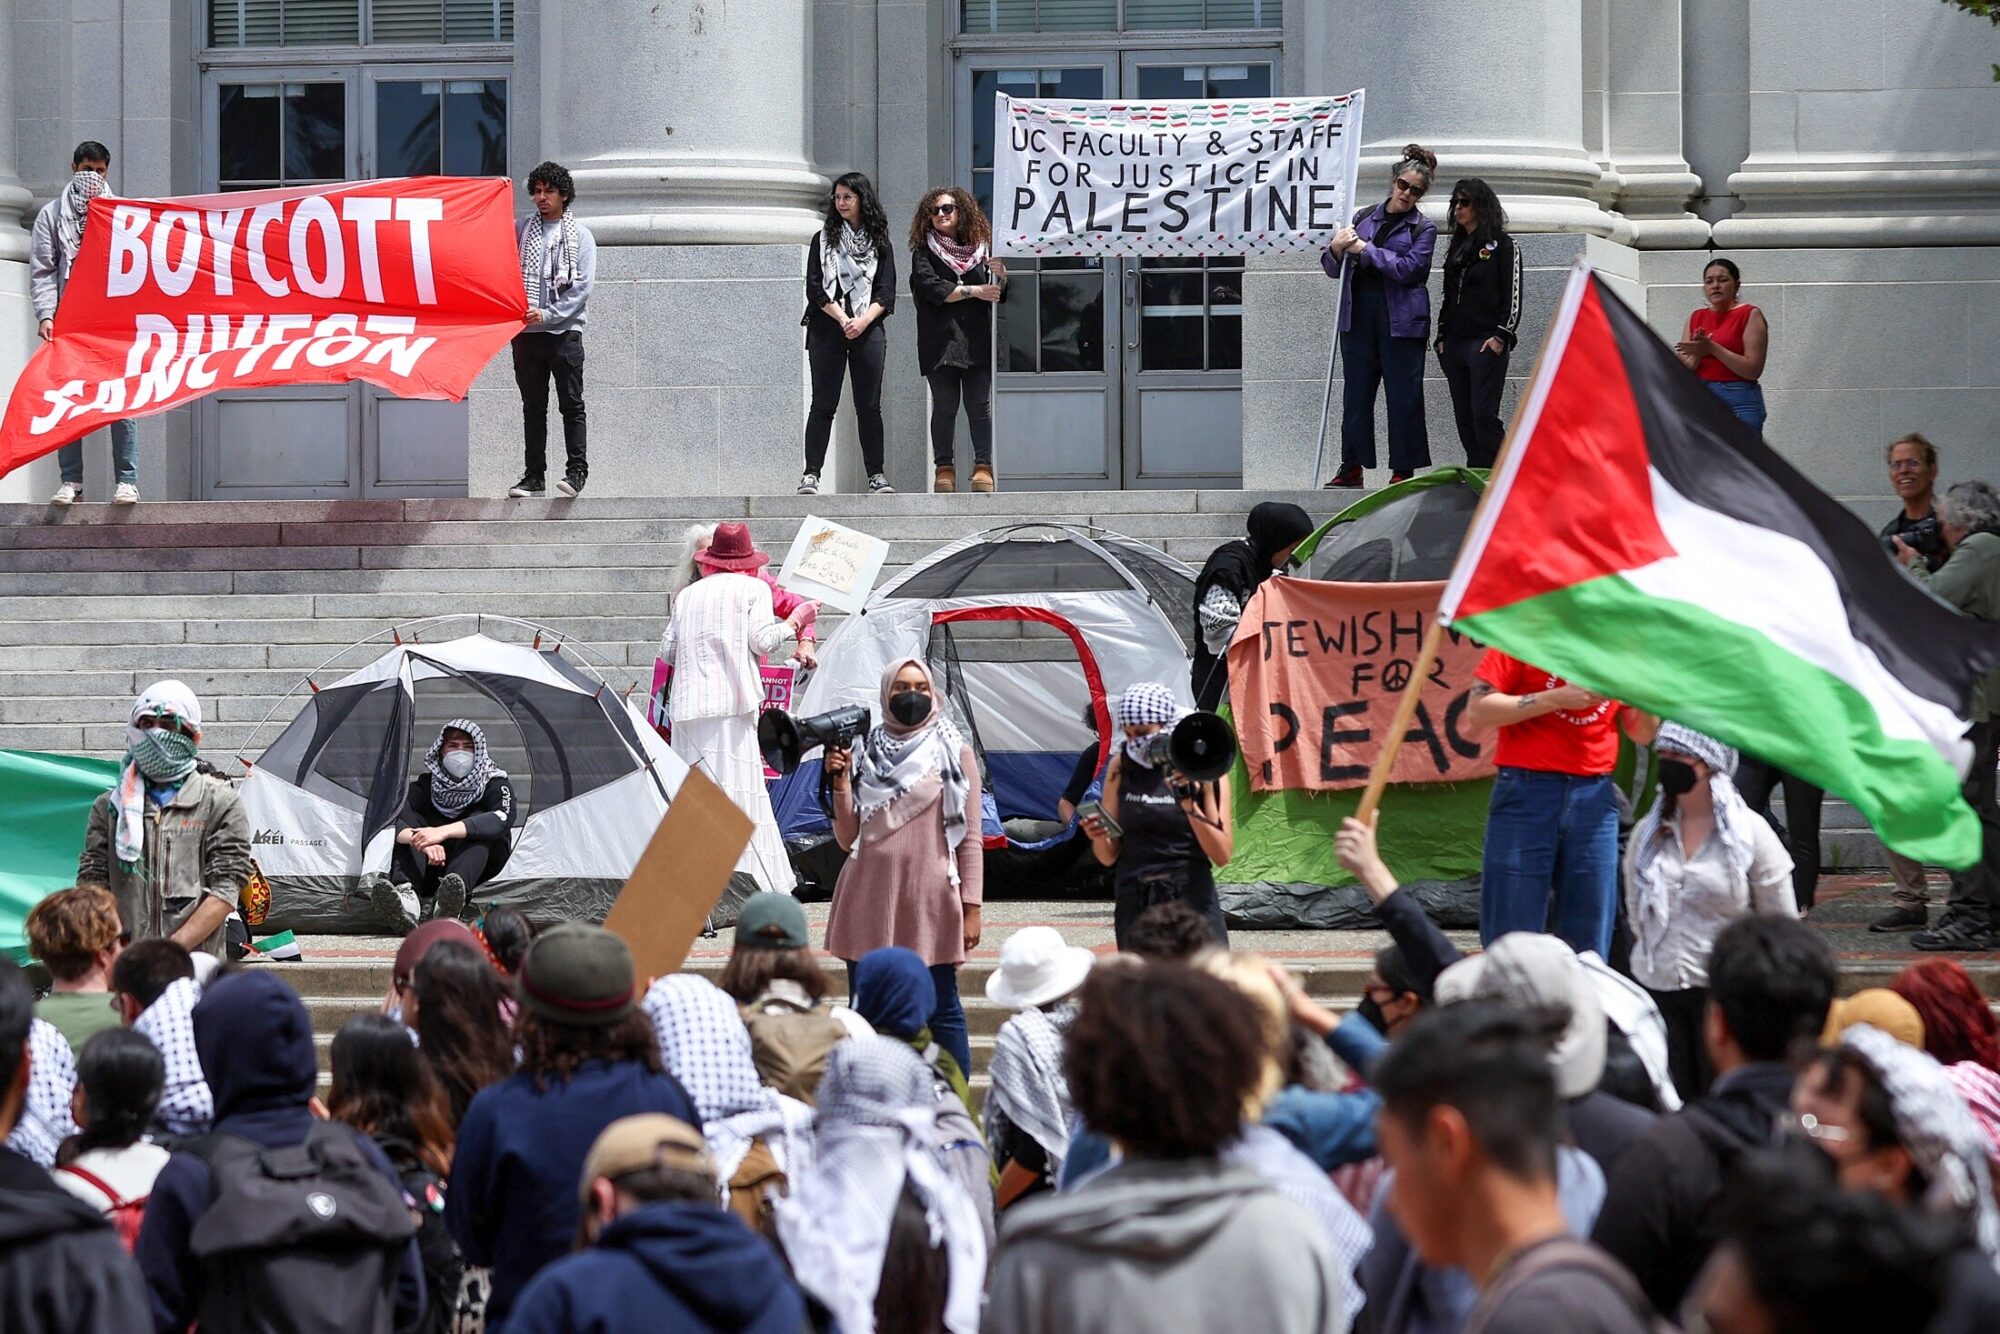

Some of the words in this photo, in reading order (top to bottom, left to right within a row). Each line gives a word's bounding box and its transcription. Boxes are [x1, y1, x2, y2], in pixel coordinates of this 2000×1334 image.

[1012, 127, 1046, 152] UC
[1062, 131, 1187, 156] FACULTY
[1205, 131, 1228, 155] &
[1248, 124, 1343, 153] STAFF
[1026, 160, 1092, 187] FOR
[1112, 160, 1270, 188] JUSTICE
[1287, 157, 1319, 181] IN
[1011, 185, 1335, 234] PALESTINE
[107, 196, 443, 305] BOYCOTT
[30, 335, 437, 435] SANCTION
[1264, 610, 1422, 661] JEWISH
[762, 677, 788, 685] ANNOT
[1263, 691, 1481, 784] PEAC
